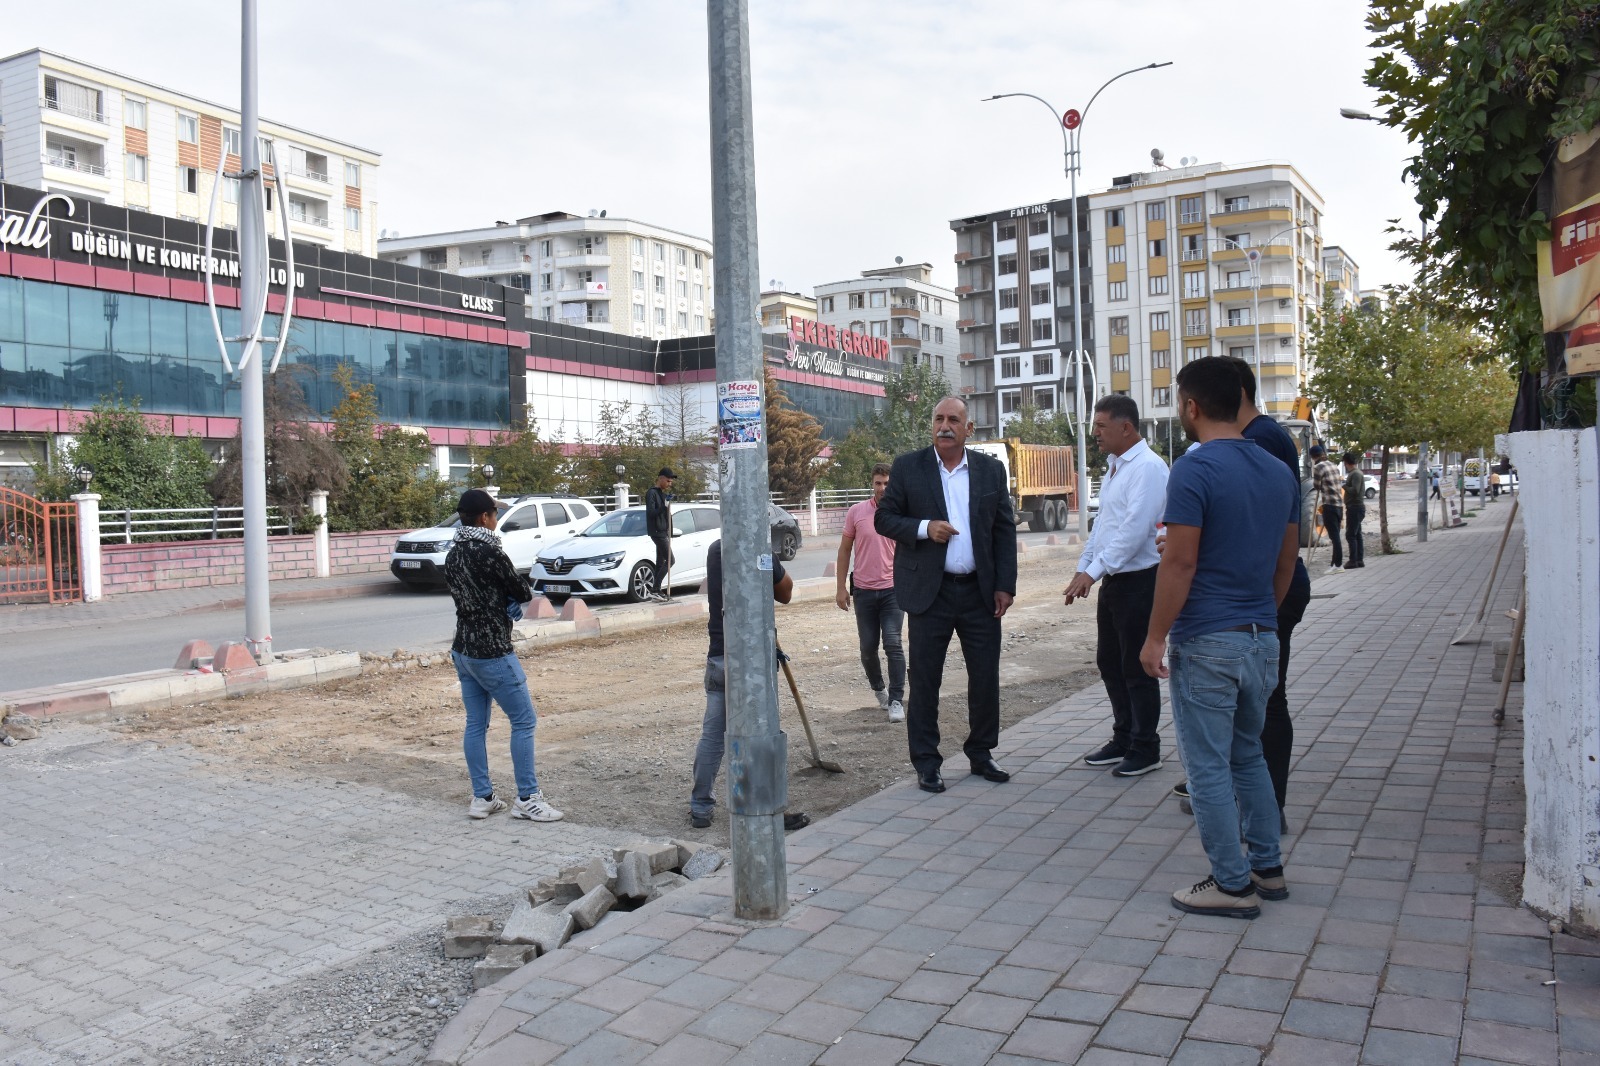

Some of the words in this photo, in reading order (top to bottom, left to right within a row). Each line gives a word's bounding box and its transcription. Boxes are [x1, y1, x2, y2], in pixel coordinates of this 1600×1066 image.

[0, 194, 75, 248] alı
[1010, 207, 1030, 218] FMT
[71, 230, 131, 260] DÜĞÜN
[136, 243, 156, 264] VE
[160, 248, 241, 278] KONFERAN
[461, 293, 494, 312] CLASS
[791, 315, 839, 350] EKER
[841, 328, 890, 361] GROUP
[790, 345, 810, 370] Peri
